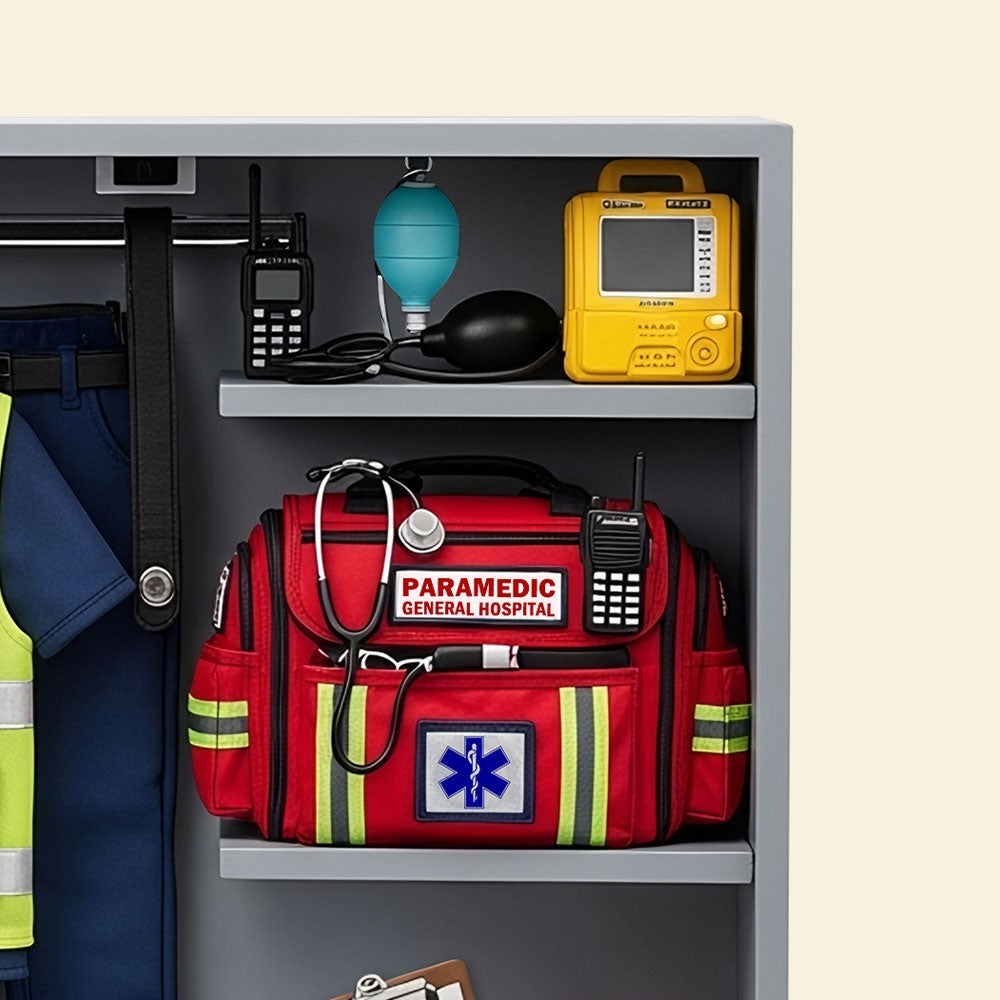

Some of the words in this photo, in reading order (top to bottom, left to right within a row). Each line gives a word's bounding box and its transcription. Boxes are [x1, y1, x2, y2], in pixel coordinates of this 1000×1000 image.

[402, 577, 556, 598] PARAMEDIC
[402, 601, 474, 616] GENERAL
[479, 602, 555, 617] HOSPITAL
